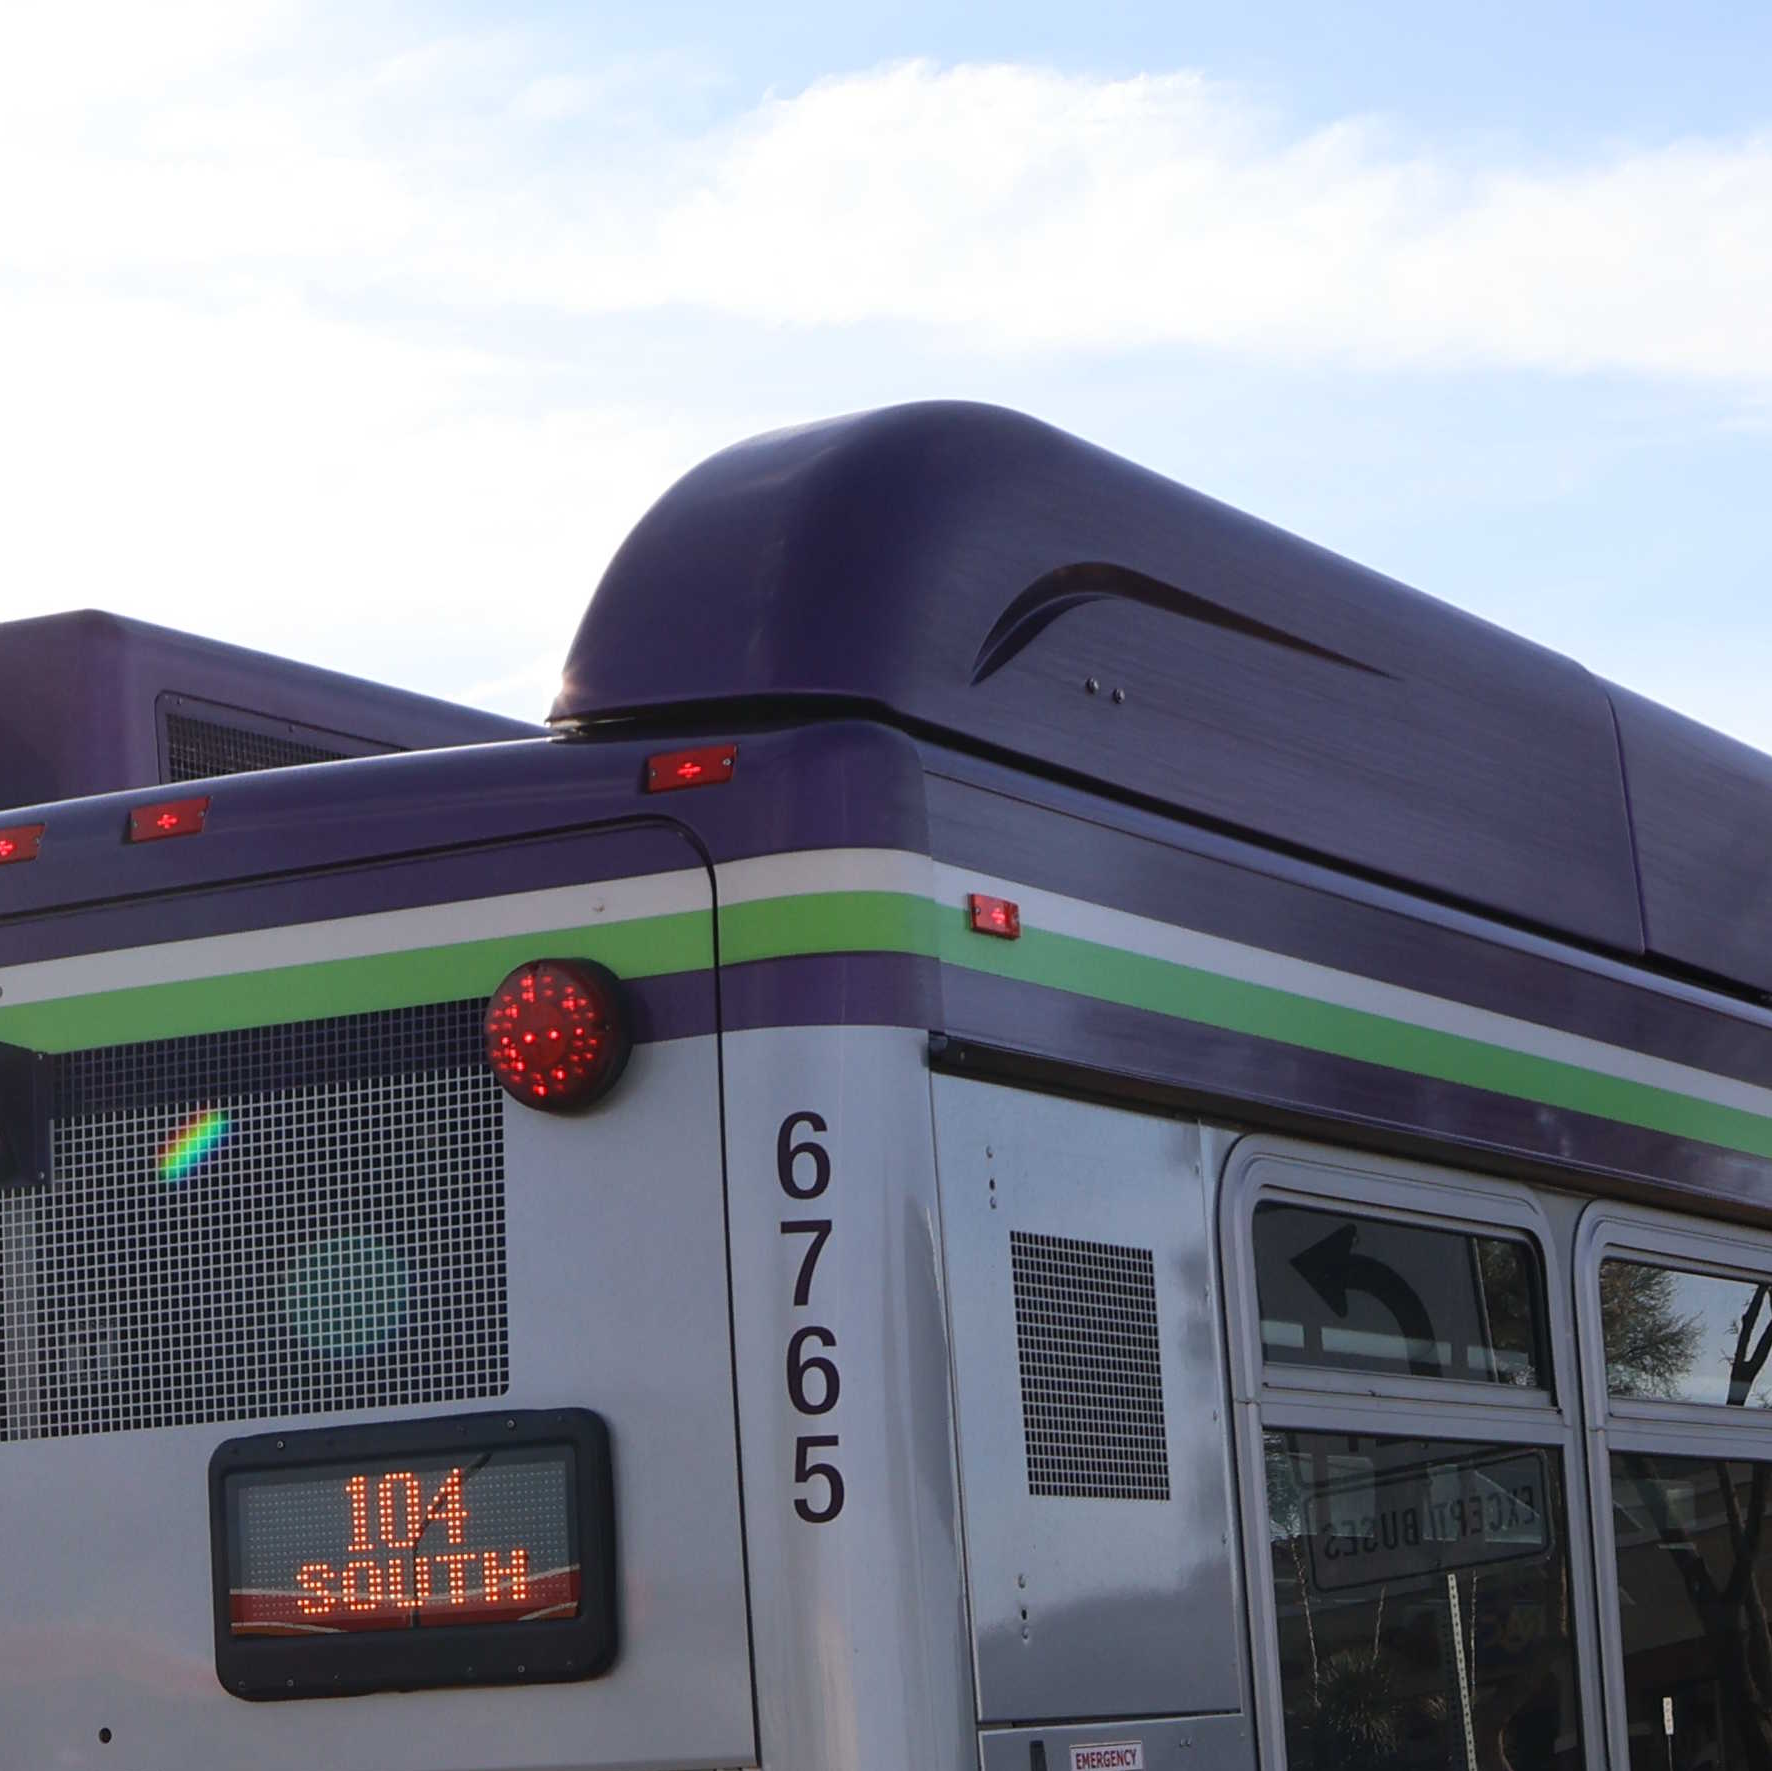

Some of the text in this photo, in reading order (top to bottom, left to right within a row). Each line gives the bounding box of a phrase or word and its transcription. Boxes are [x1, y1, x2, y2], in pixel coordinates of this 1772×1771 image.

[775, 1110, 847, 1525] 6765
[344, 1466, 469, 1552] 104
[295, 1547, 531, 1616] SOUTH
[1075, 1748, 1138, 1770] EMERGENCY
